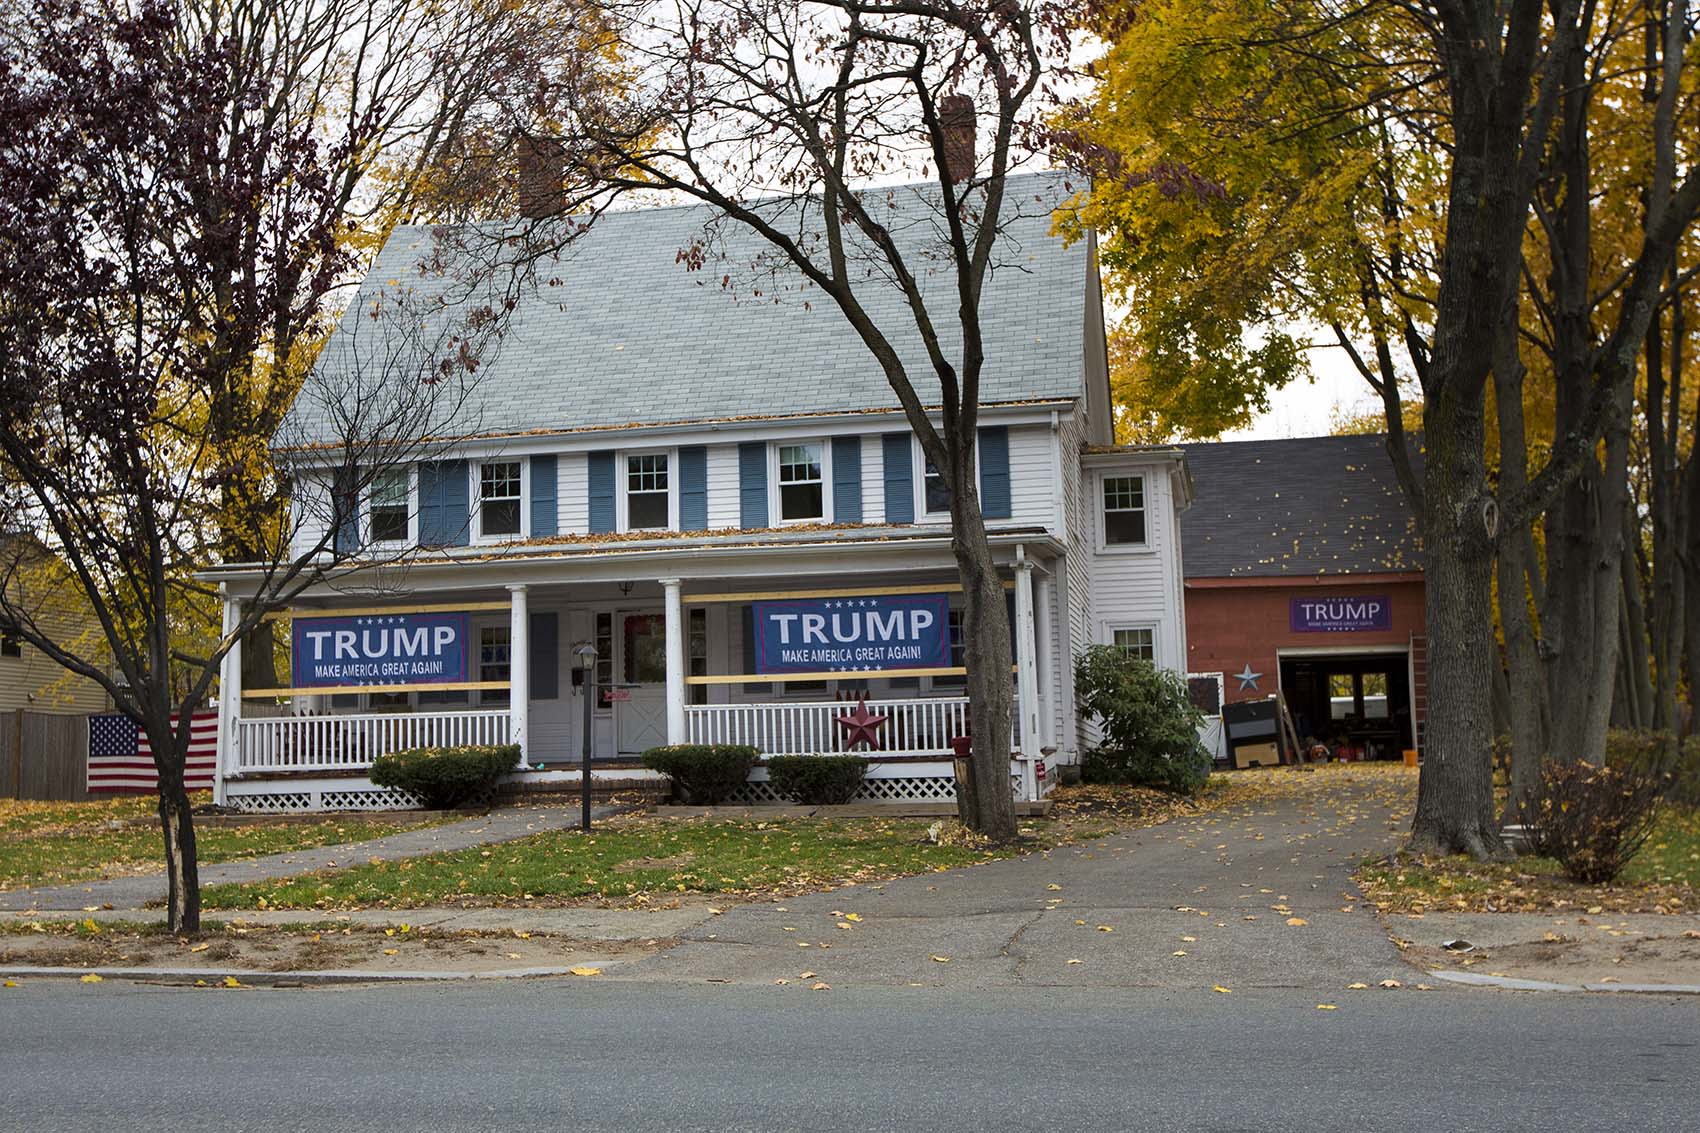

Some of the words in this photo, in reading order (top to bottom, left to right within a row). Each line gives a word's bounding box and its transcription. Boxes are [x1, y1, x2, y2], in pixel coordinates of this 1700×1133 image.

[1301, 603, 1380, 620] TRUMP
[770, 609, 934, 644] TRUMP
[306, 626, 456, 660] TRUMP
[782, 649, 809, 663] MAKE
[811, 648, 853, 662] AMERICA
[855, 647, 885, 661] GREAT
[887, 646, 921, 659] AGAIN!
[315, 664, 340, 678] MAKE
[342, 663, 379, 677] AMERICA
[381, 662, 409, 676] GREAT
[411, 661, 443, 674] AGAIN!
